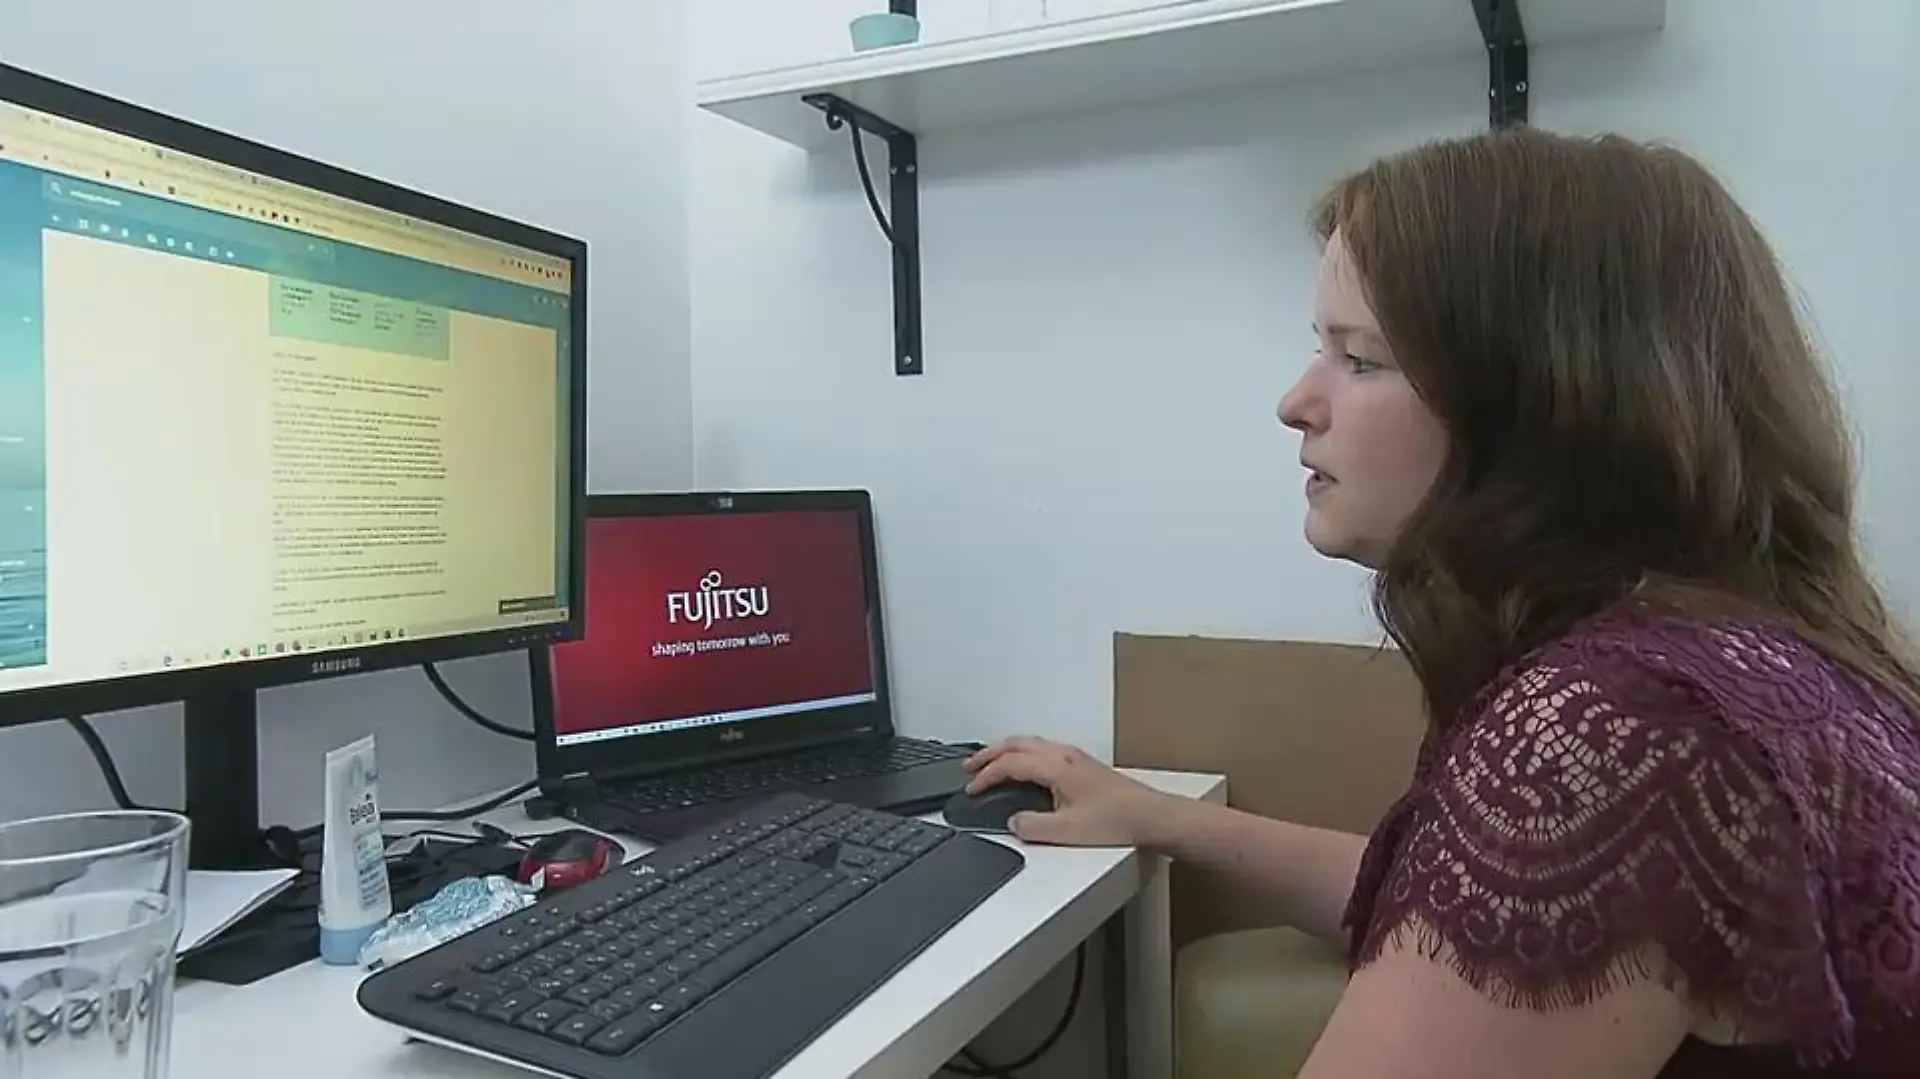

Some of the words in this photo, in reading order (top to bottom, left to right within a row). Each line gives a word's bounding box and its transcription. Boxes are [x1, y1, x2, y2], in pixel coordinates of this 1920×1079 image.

[667, 570, 769, 630] FUJITSU
[652, 641, 695, 657] shaping
[697, 637, 746, 651] tomorrow
[748, 632, 770, 646] with
